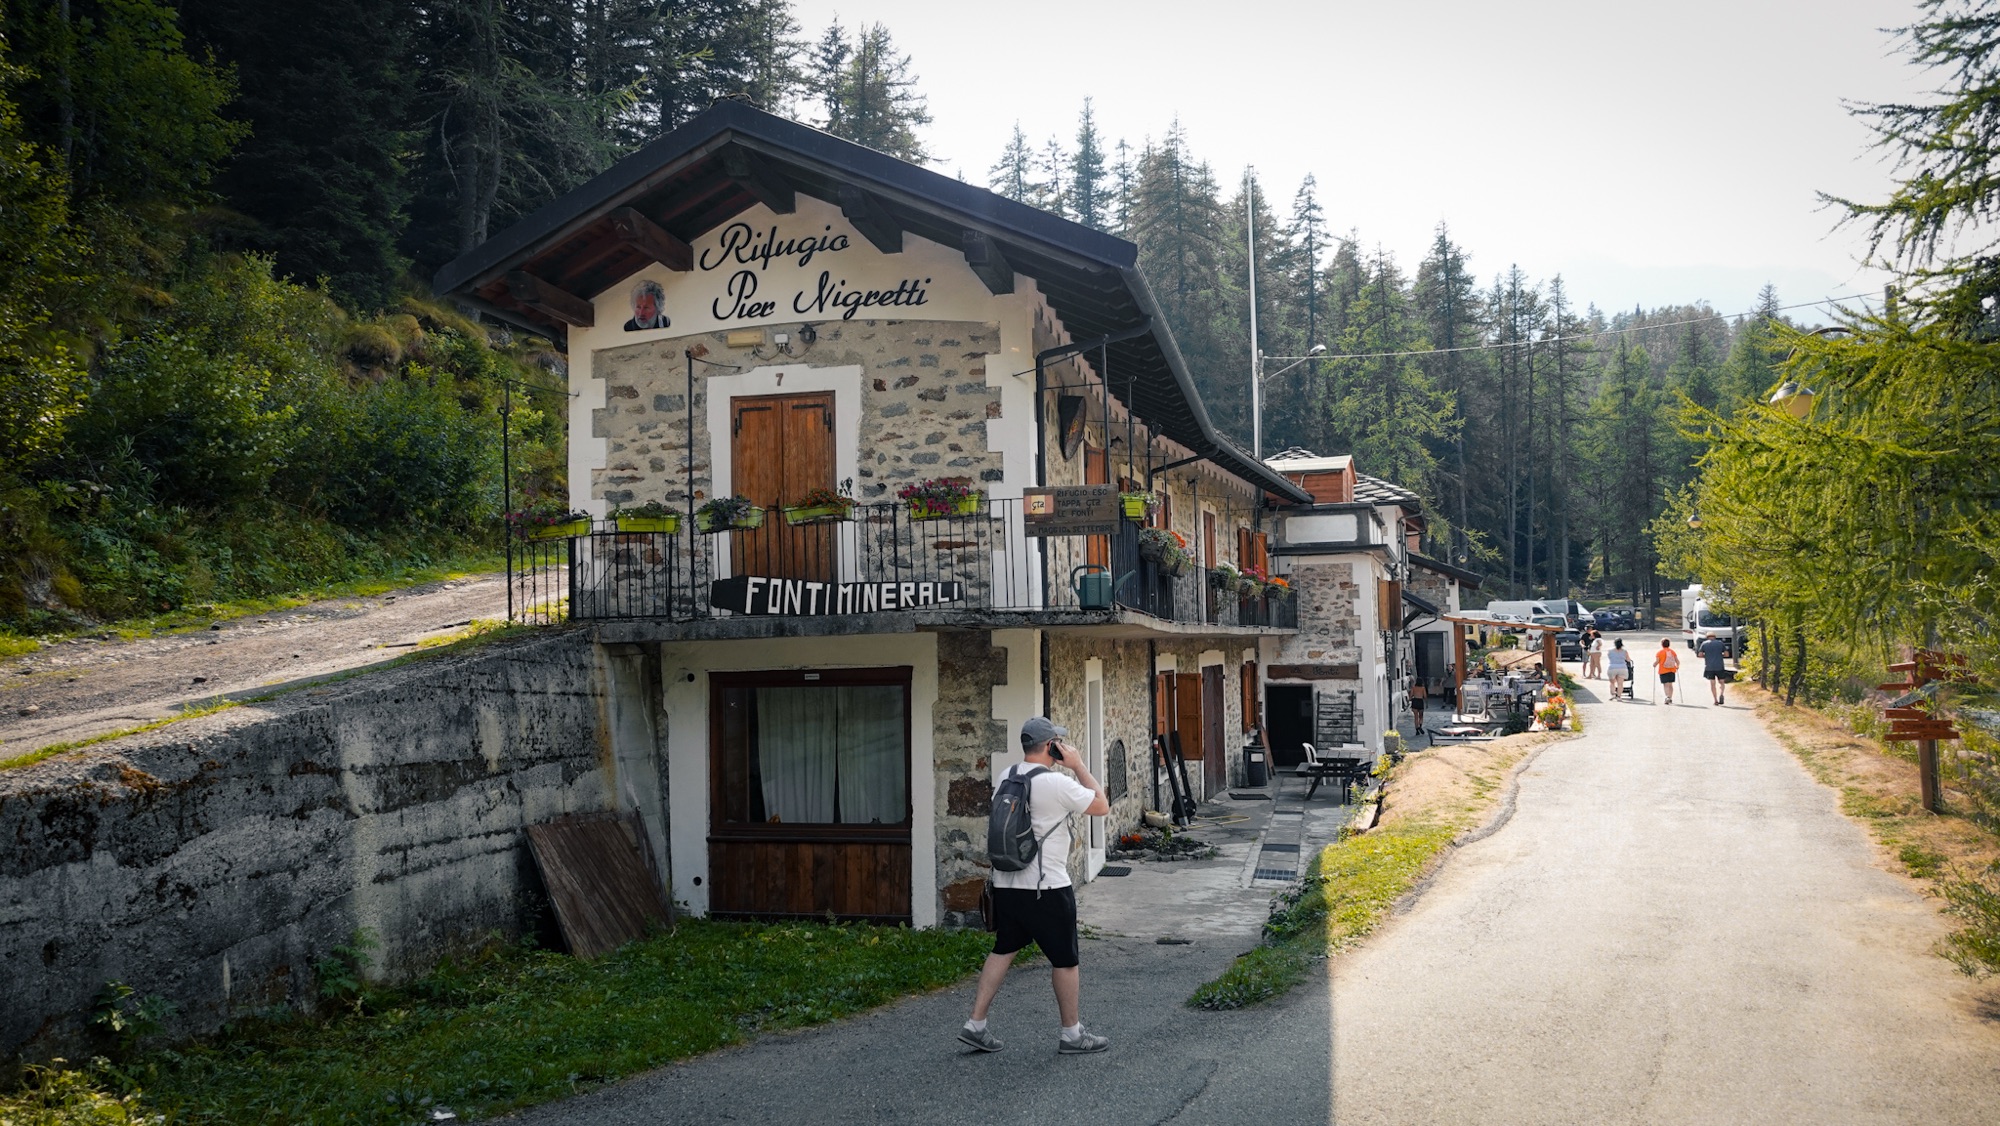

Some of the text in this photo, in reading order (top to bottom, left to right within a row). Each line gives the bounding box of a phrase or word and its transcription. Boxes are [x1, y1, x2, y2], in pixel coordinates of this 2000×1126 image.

[700, 222, 850, 271] Rifugio
[712, 270, 932, 321] Pier Nigretti
[775, 372, 784, 386] 7
[1056, 489, 1088, 497] RIFUGIO
[1071, 509, 1094, 517] FONTI
[1038, 526, 1067, 534] MAGGIO
[1072, 524, 1116, 533] SETTEMBRE
[745, 576, 958, 615] FONTI MINERALI
